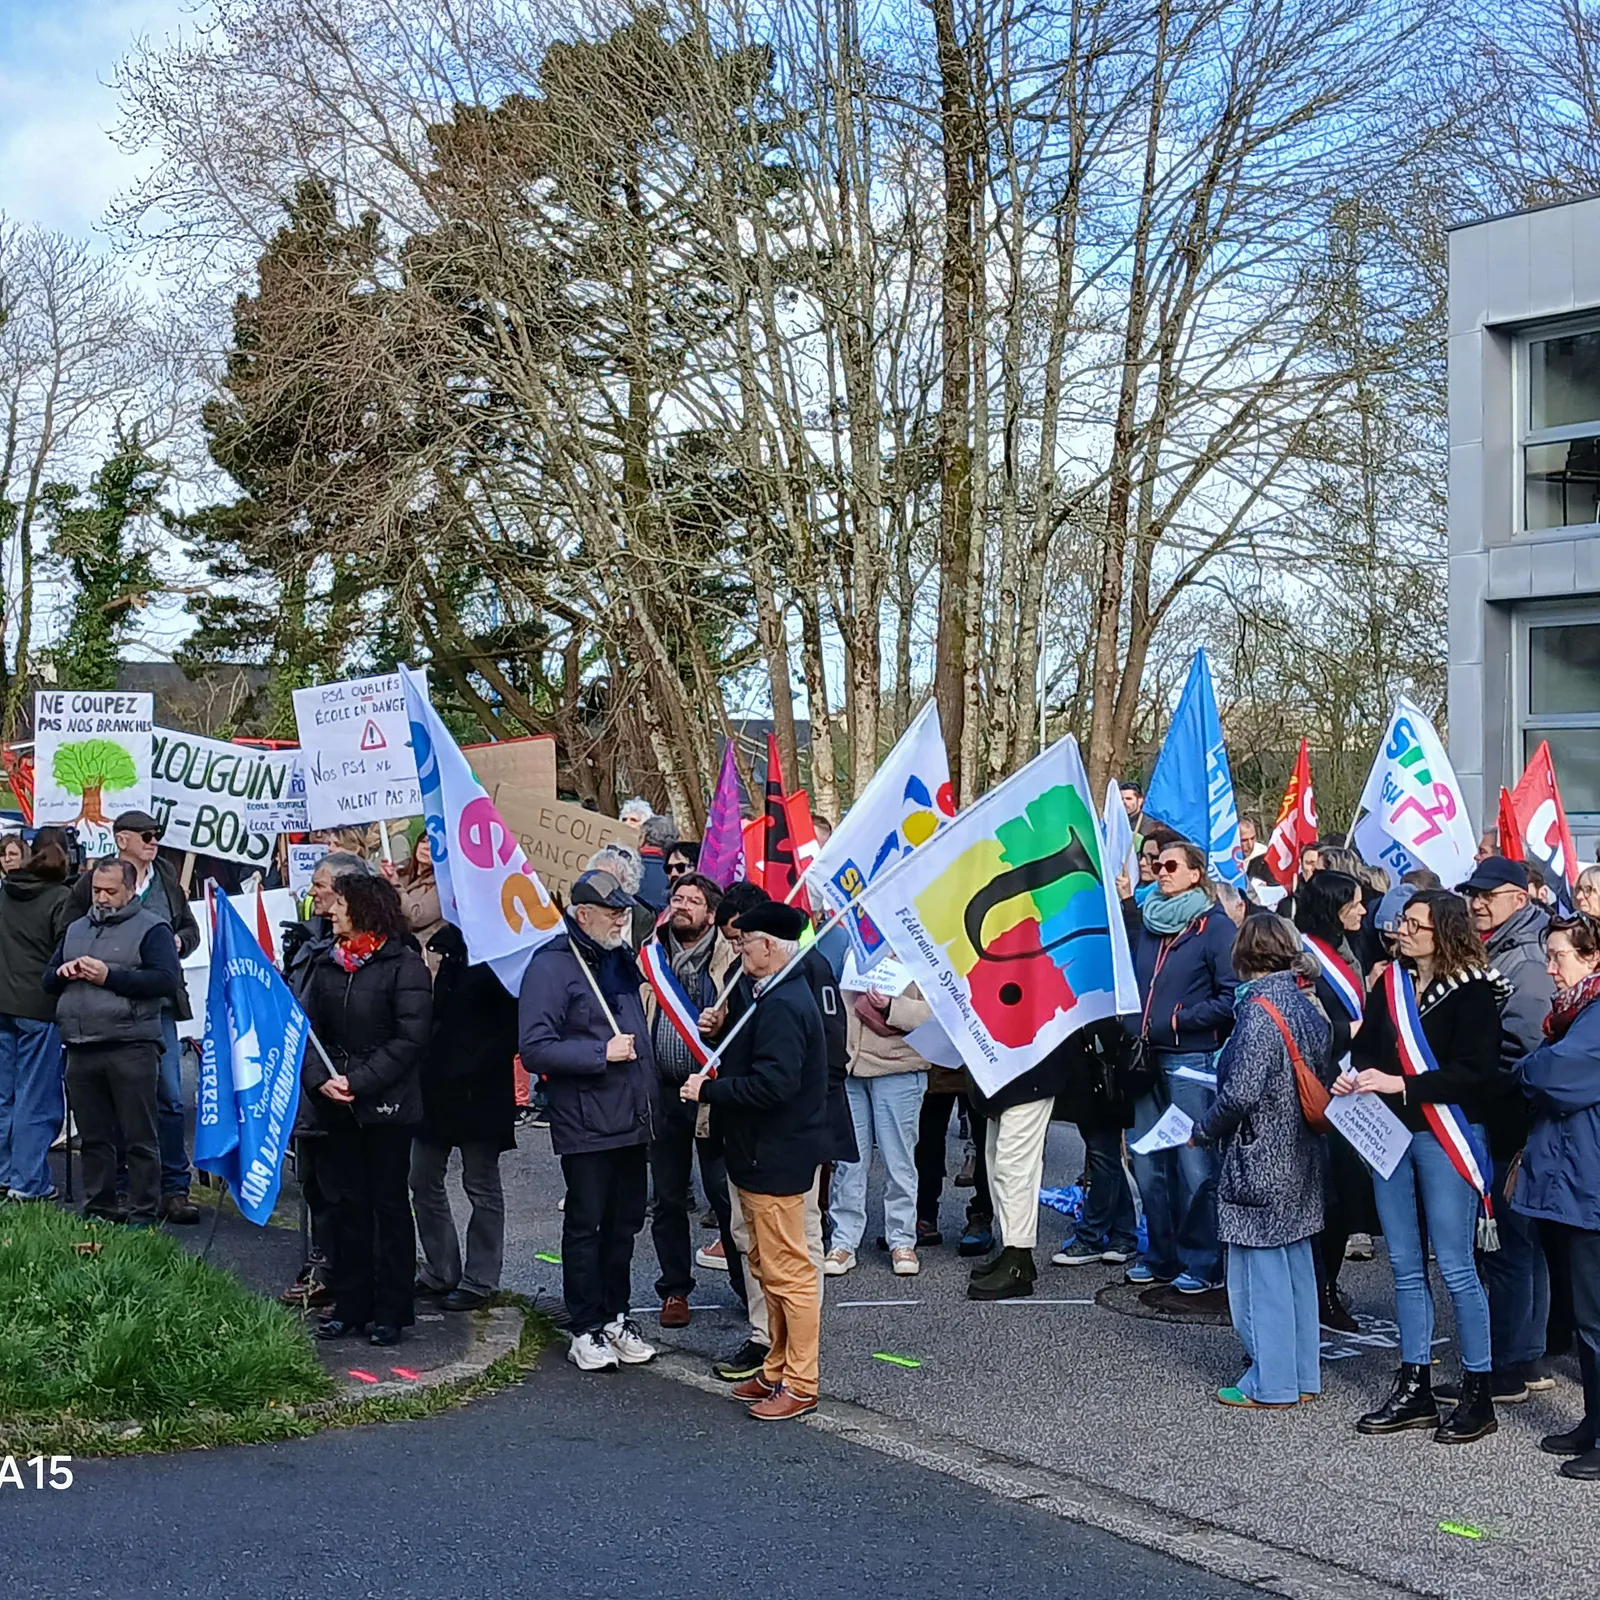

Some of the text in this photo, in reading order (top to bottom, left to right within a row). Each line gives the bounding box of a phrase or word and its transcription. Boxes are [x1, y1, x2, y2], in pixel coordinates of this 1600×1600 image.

[322, 677, 400, 703] PS1 OUBLIÉS
[40, 694, 138, 714] NE COUPEZ
[315, 709, 350, 725] ÉCOLE
[355, 704, 367, 716] EN
[38, 717, 152, 732] PAS NOS BRANCHES
[342, 759, 366, 776] PS1
[337, 789, 421, 811] VALENT PAS RI
[539, 808, 612, 849] ECOLE
[895, 906, 940, 968] Fédération
[968, 1020, 999, 1064] Unitaire
[200, 1039, 218, 1126] GUERRES
